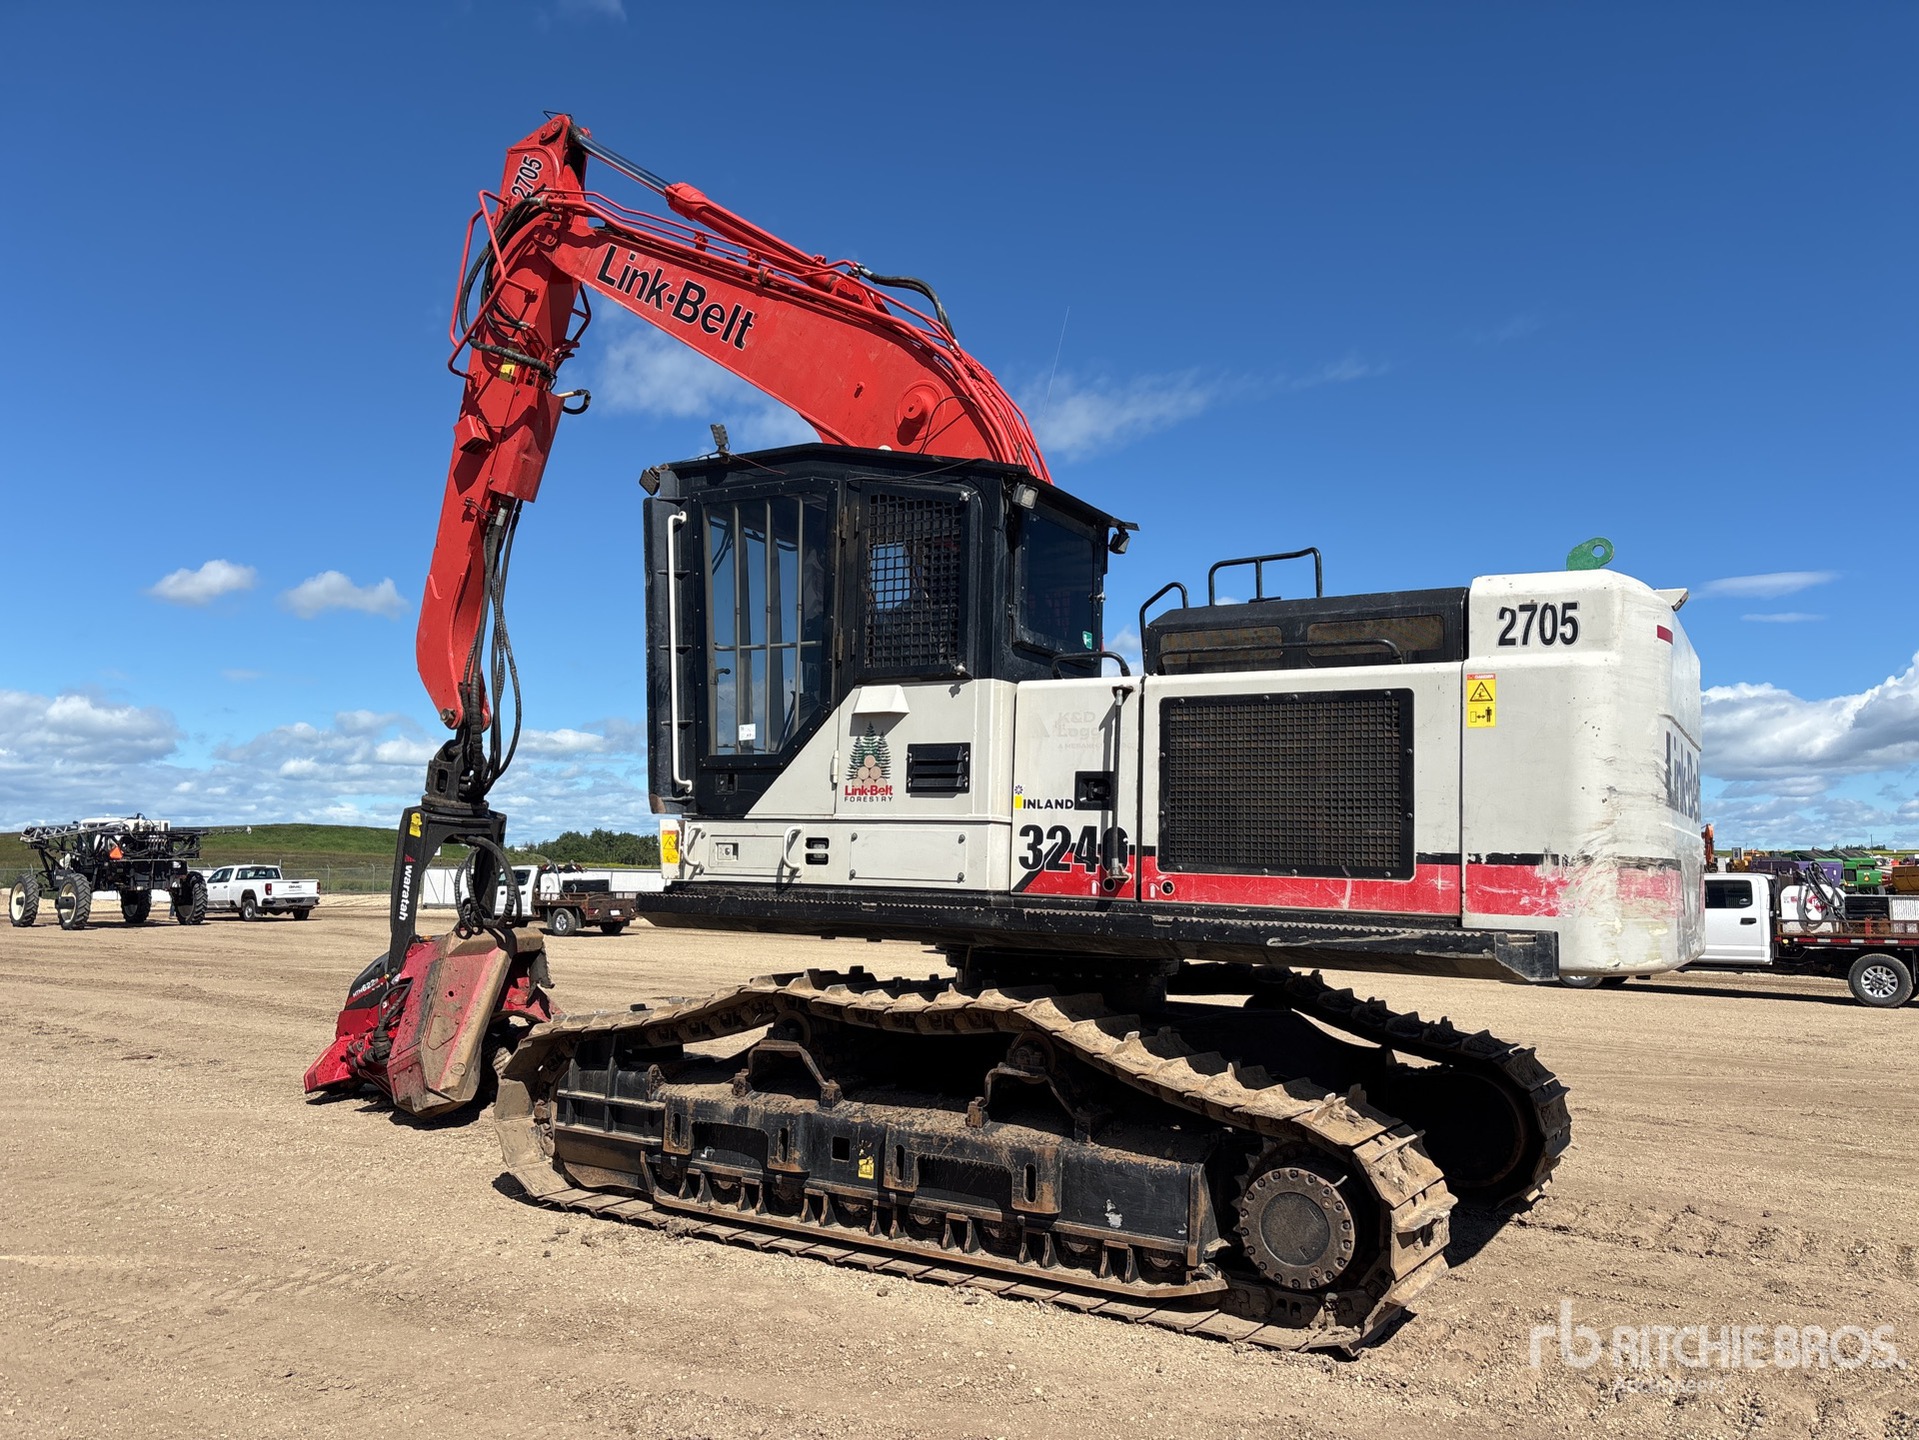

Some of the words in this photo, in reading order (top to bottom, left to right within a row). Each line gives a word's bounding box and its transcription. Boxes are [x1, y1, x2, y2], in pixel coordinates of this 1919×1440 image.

[511, 155, 542, 199] 2705
[597, 244, 754, 351] Link-Belt
[1498, 602, 1579, 646] 2705
[845, 784, 893, 796] Link-Belt
[1023, 798, 1074, 809] INLAND
[1018, 824, 1129, 874] 3240
[399, 865, 412, 920] waratah
